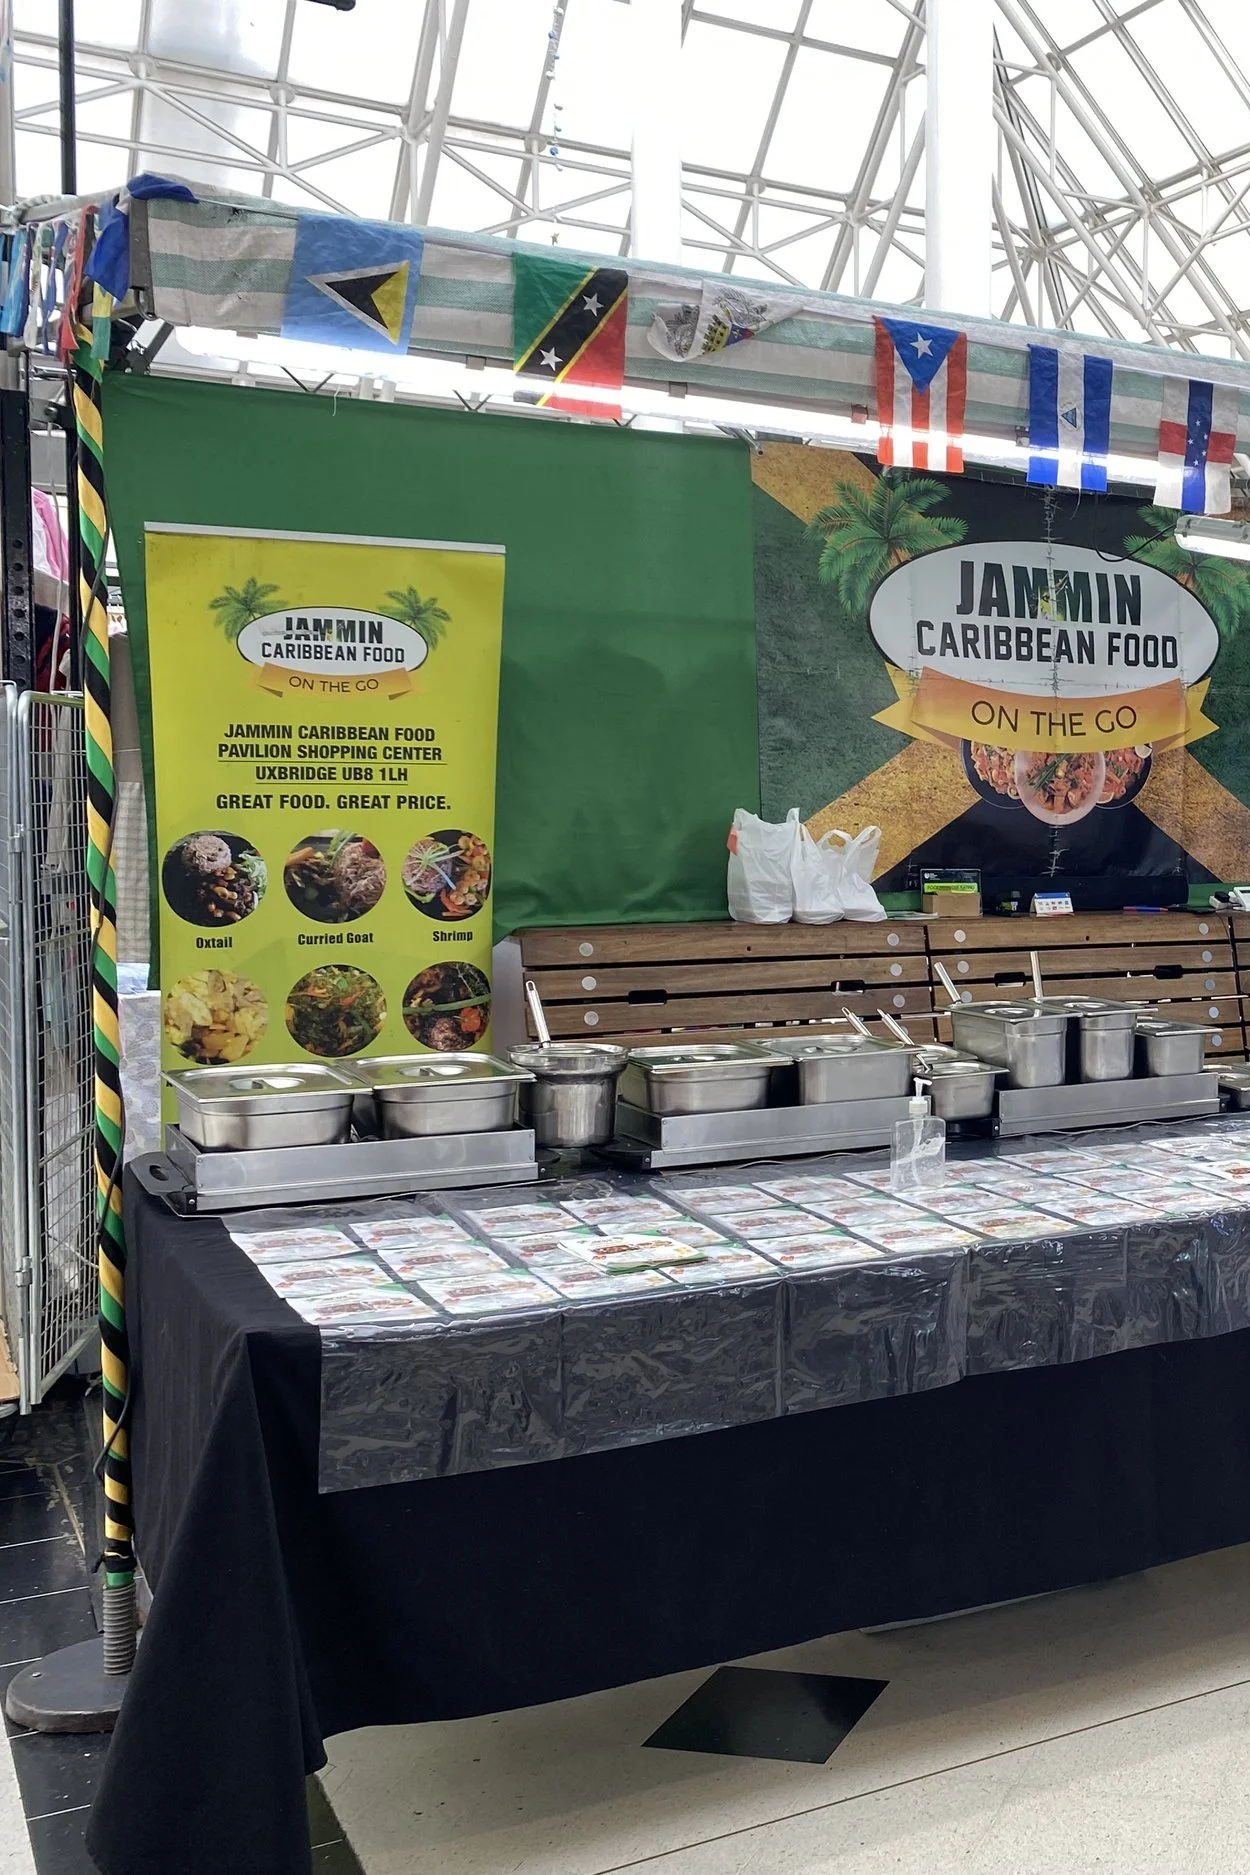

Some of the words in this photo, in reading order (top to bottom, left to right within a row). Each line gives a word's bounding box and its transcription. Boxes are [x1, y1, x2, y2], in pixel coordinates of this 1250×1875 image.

[955, 560, 1142, 626] JAMMIN
[284, 616, 383, 644] JAMMIN
[917, 619, 1096, 665] CARIBBEAN
[1107, 632, 1178, 668] FOOD
[261, 643, 357, 662] CARIBBEAN
[364, 646, 405, 663] FOOD
[289, 675, 314, 691] ON
[319, 680, 350, 693] THE
[355, 678, 379, 693] GO
[971, 700, 1019, 733] ON
[1030, 710, 1086, 736] THE
[1095, 705, 1137, 734] GO
[223, 723, 293, 739] JAMMIN
[297, 725, 389, 741] CARIBBEAN
[394, 727, 435, 742] FOOD
[218, 744, 292, 759] PAVILION
[297, 745, 377, 760] SHOPPING
[382, 746, 442, 761] CENTER
[255, 766, 337, 781] UXBRIDGE
[342, 766, 373, 781] UB8
[379, 767, 408, 782] 1LH
[216, 794, 273, 809] GREAT
[279, 794, 330, 809] FOOD.
[337, 795, 391, 809] GREAT
[396, 795, 451, 810] PRICE.
[195, 936, 233, 949] Oxtail
[297, 932, 343, 946] Curried
[346, 931, 374, 944] Goat
[432, 929, 473, 943] Shrimp
